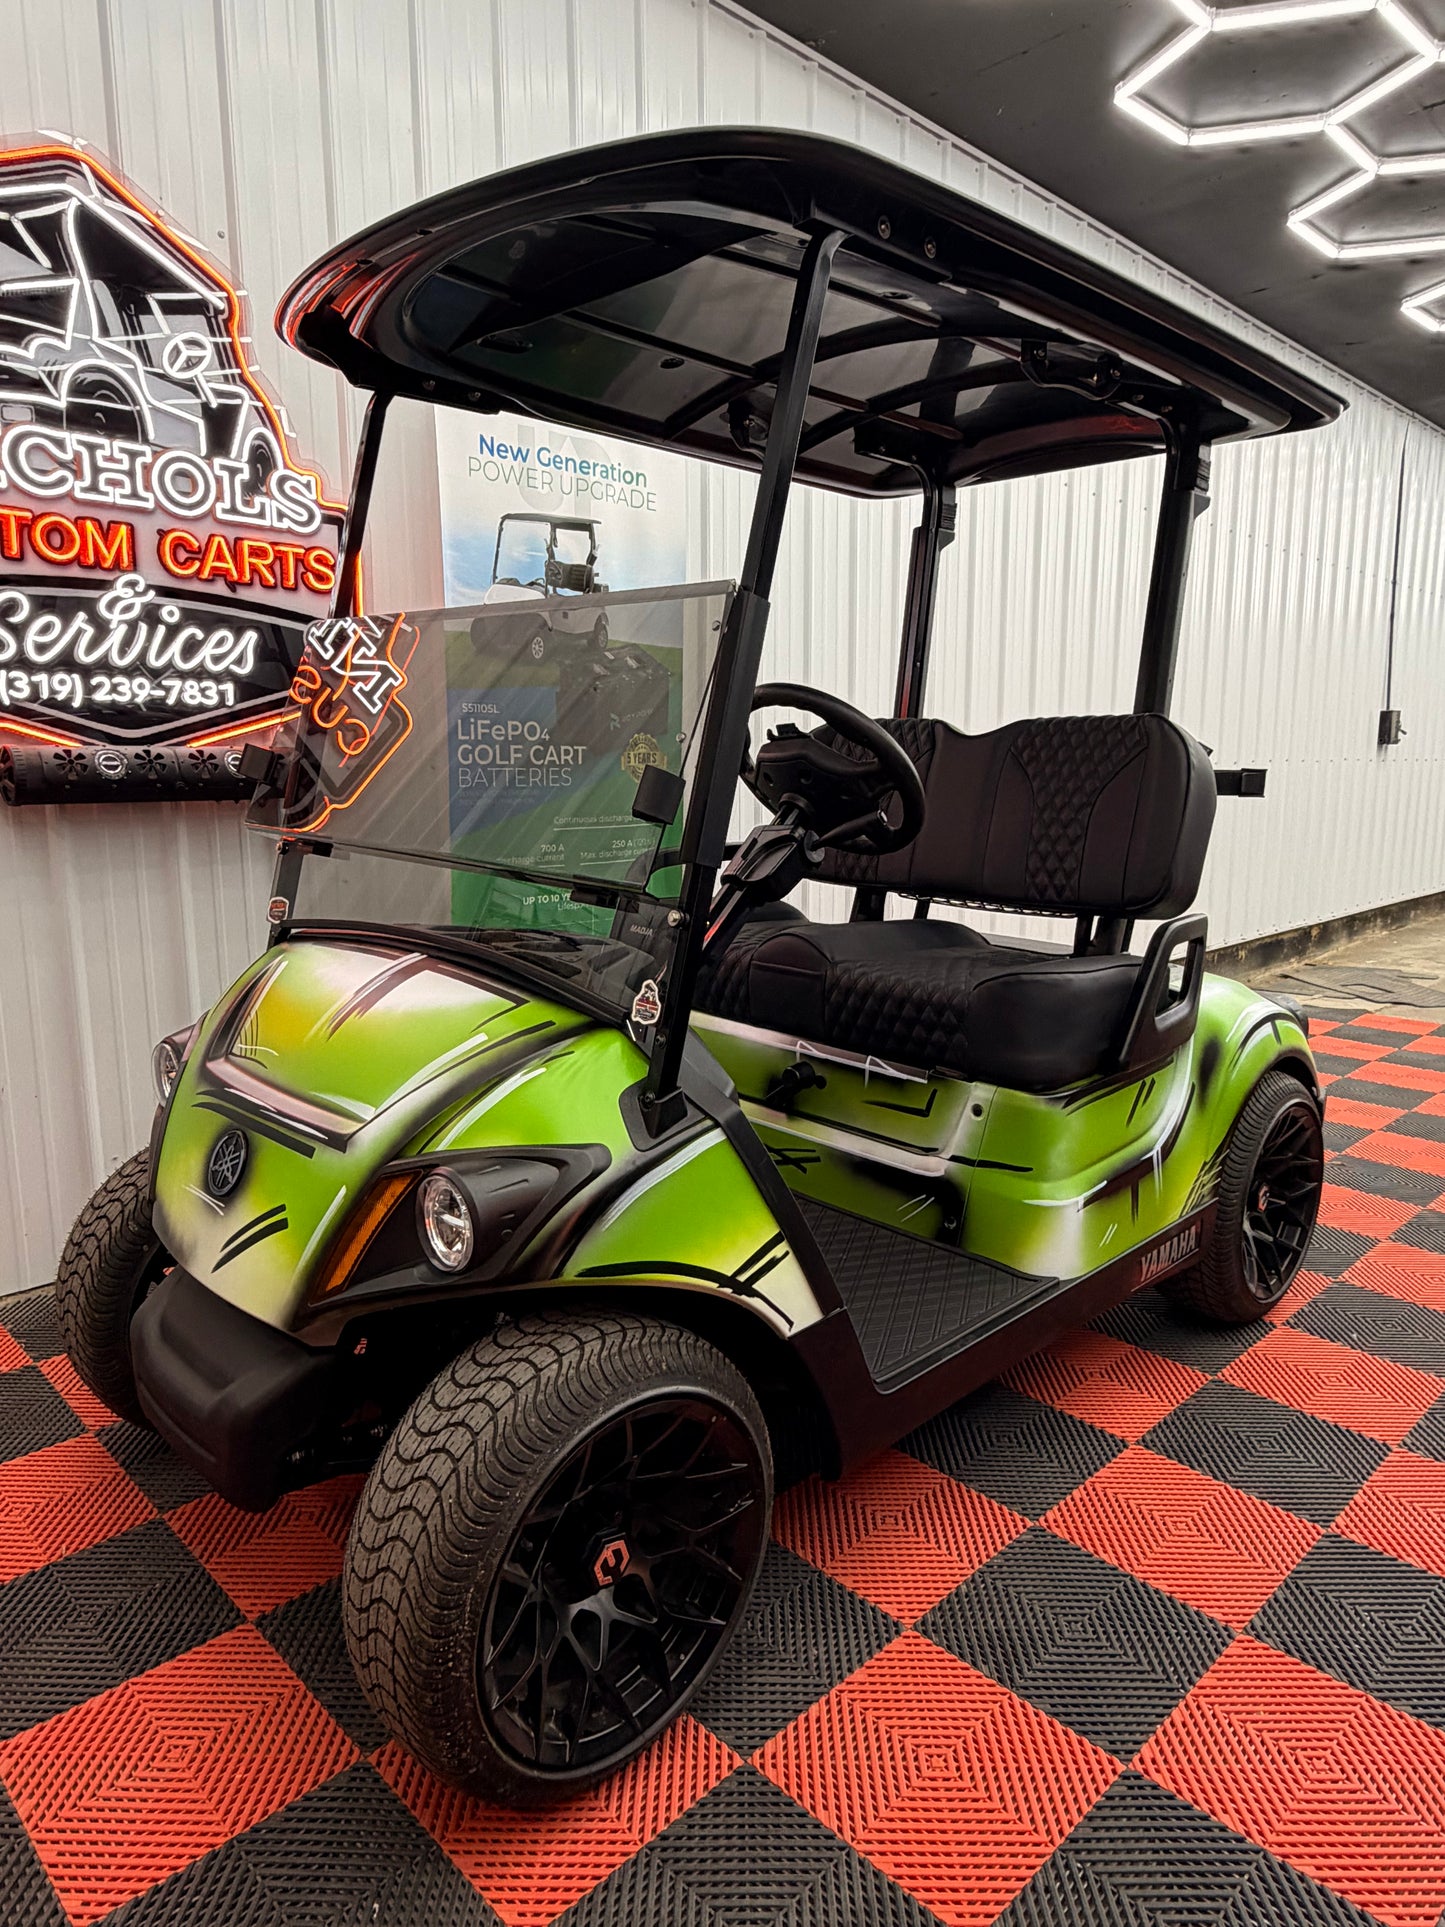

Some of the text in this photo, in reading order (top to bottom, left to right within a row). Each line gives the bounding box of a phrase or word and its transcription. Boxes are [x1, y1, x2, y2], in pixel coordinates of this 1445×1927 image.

[0, 424, 321, 535] CHOLS
[479, 434, 648, 488] New Generation
[468, 456, 657, 512] POWER UPGRADE
[157, 528, 336, 594] CARTS
[97, 573, 155, 628] &
[0, 590, 258, 675] Services
[0, 669, 236, 708] (319) 239-7831
[457, 744, 587, 766] GOLF CART
[626, 752, 658, 764] 5 YEARS
[458, 767, 572, 788] BATTERIES
[553, 814, 598, 825] Continuous
[541, 843, 565, 853] 700 A
[612, 840, 626, 849] 250
[522, 895, 536, 906] UP
[537, 894, 550, 904] TO
[550, 894, 560, 903] 10
[1140, 1224, 1198, 1282] YAMAHA
